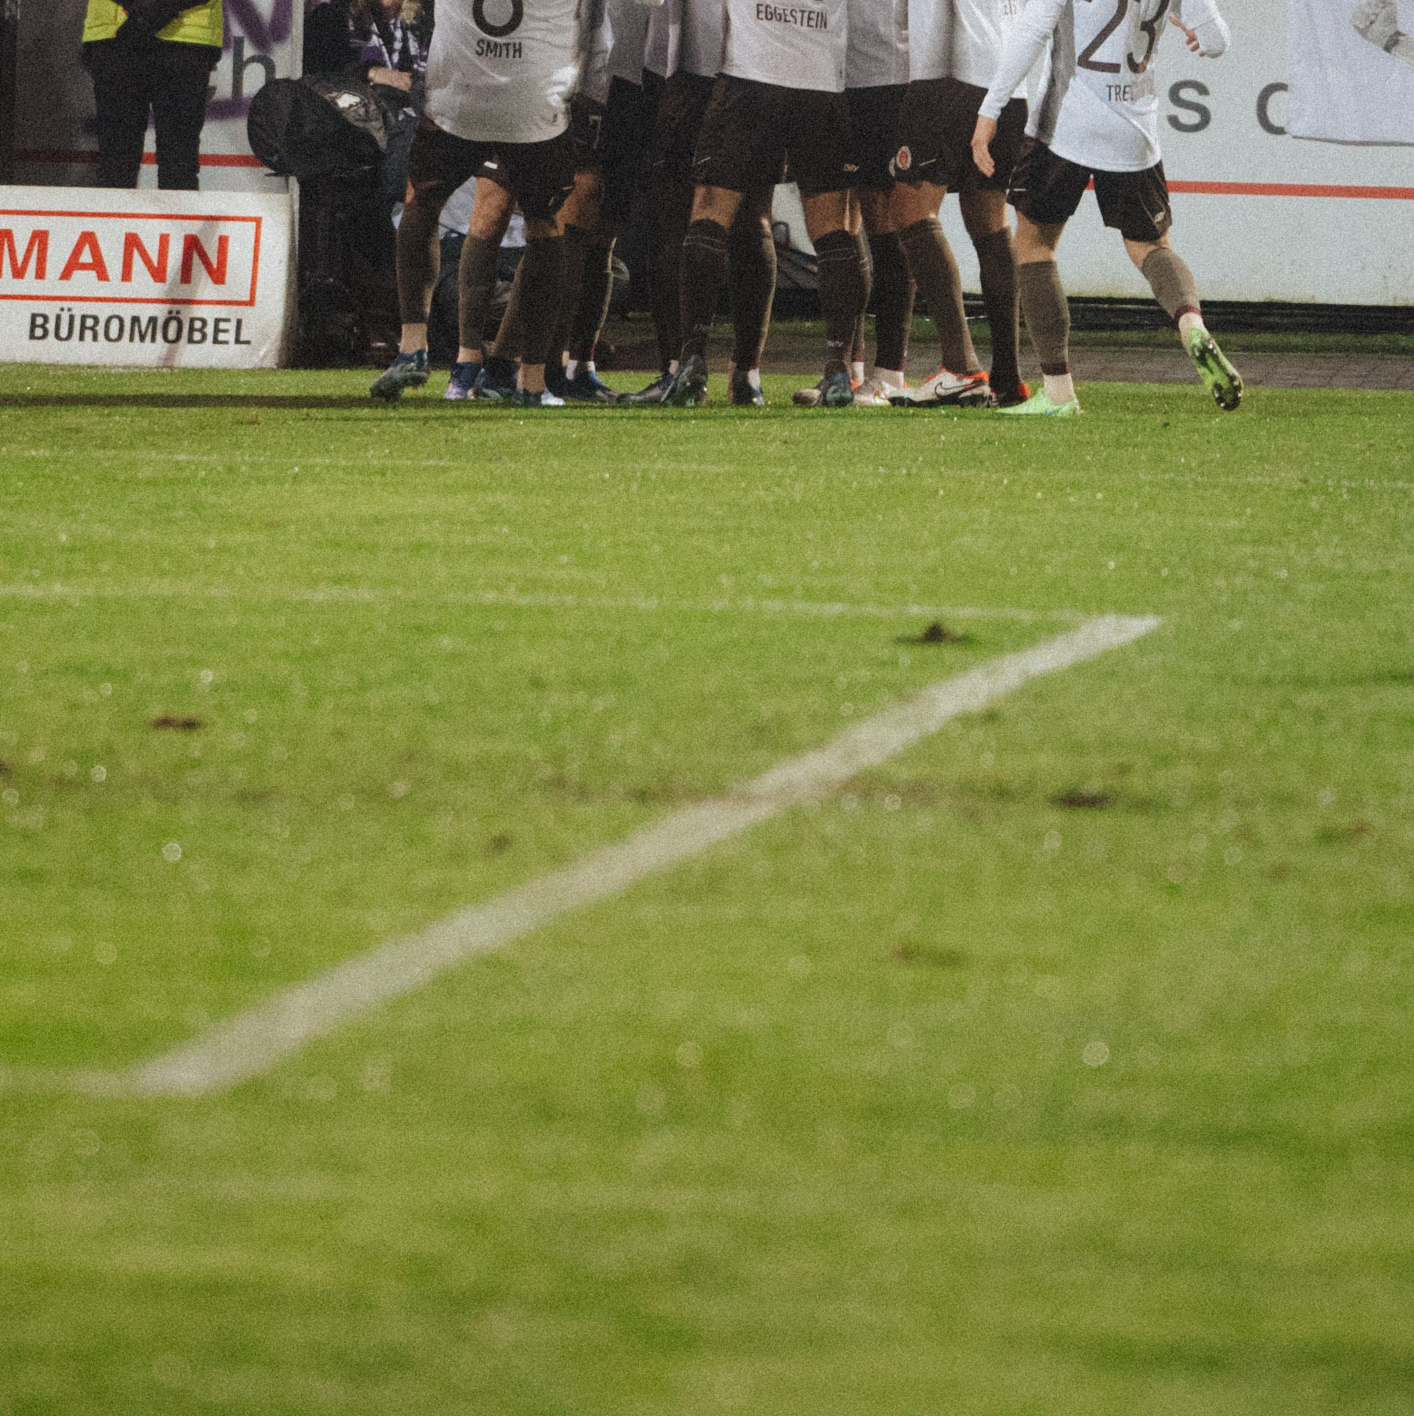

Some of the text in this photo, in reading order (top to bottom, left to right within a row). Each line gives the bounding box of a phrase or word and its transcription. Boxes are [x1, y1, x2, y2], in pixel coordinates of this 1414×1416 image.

[756, 3, 829, 30] EGGESTEIN
[475, 39, 523, 60] SMITH
[28, 311, 252, 347] BÜROMÖBEL
